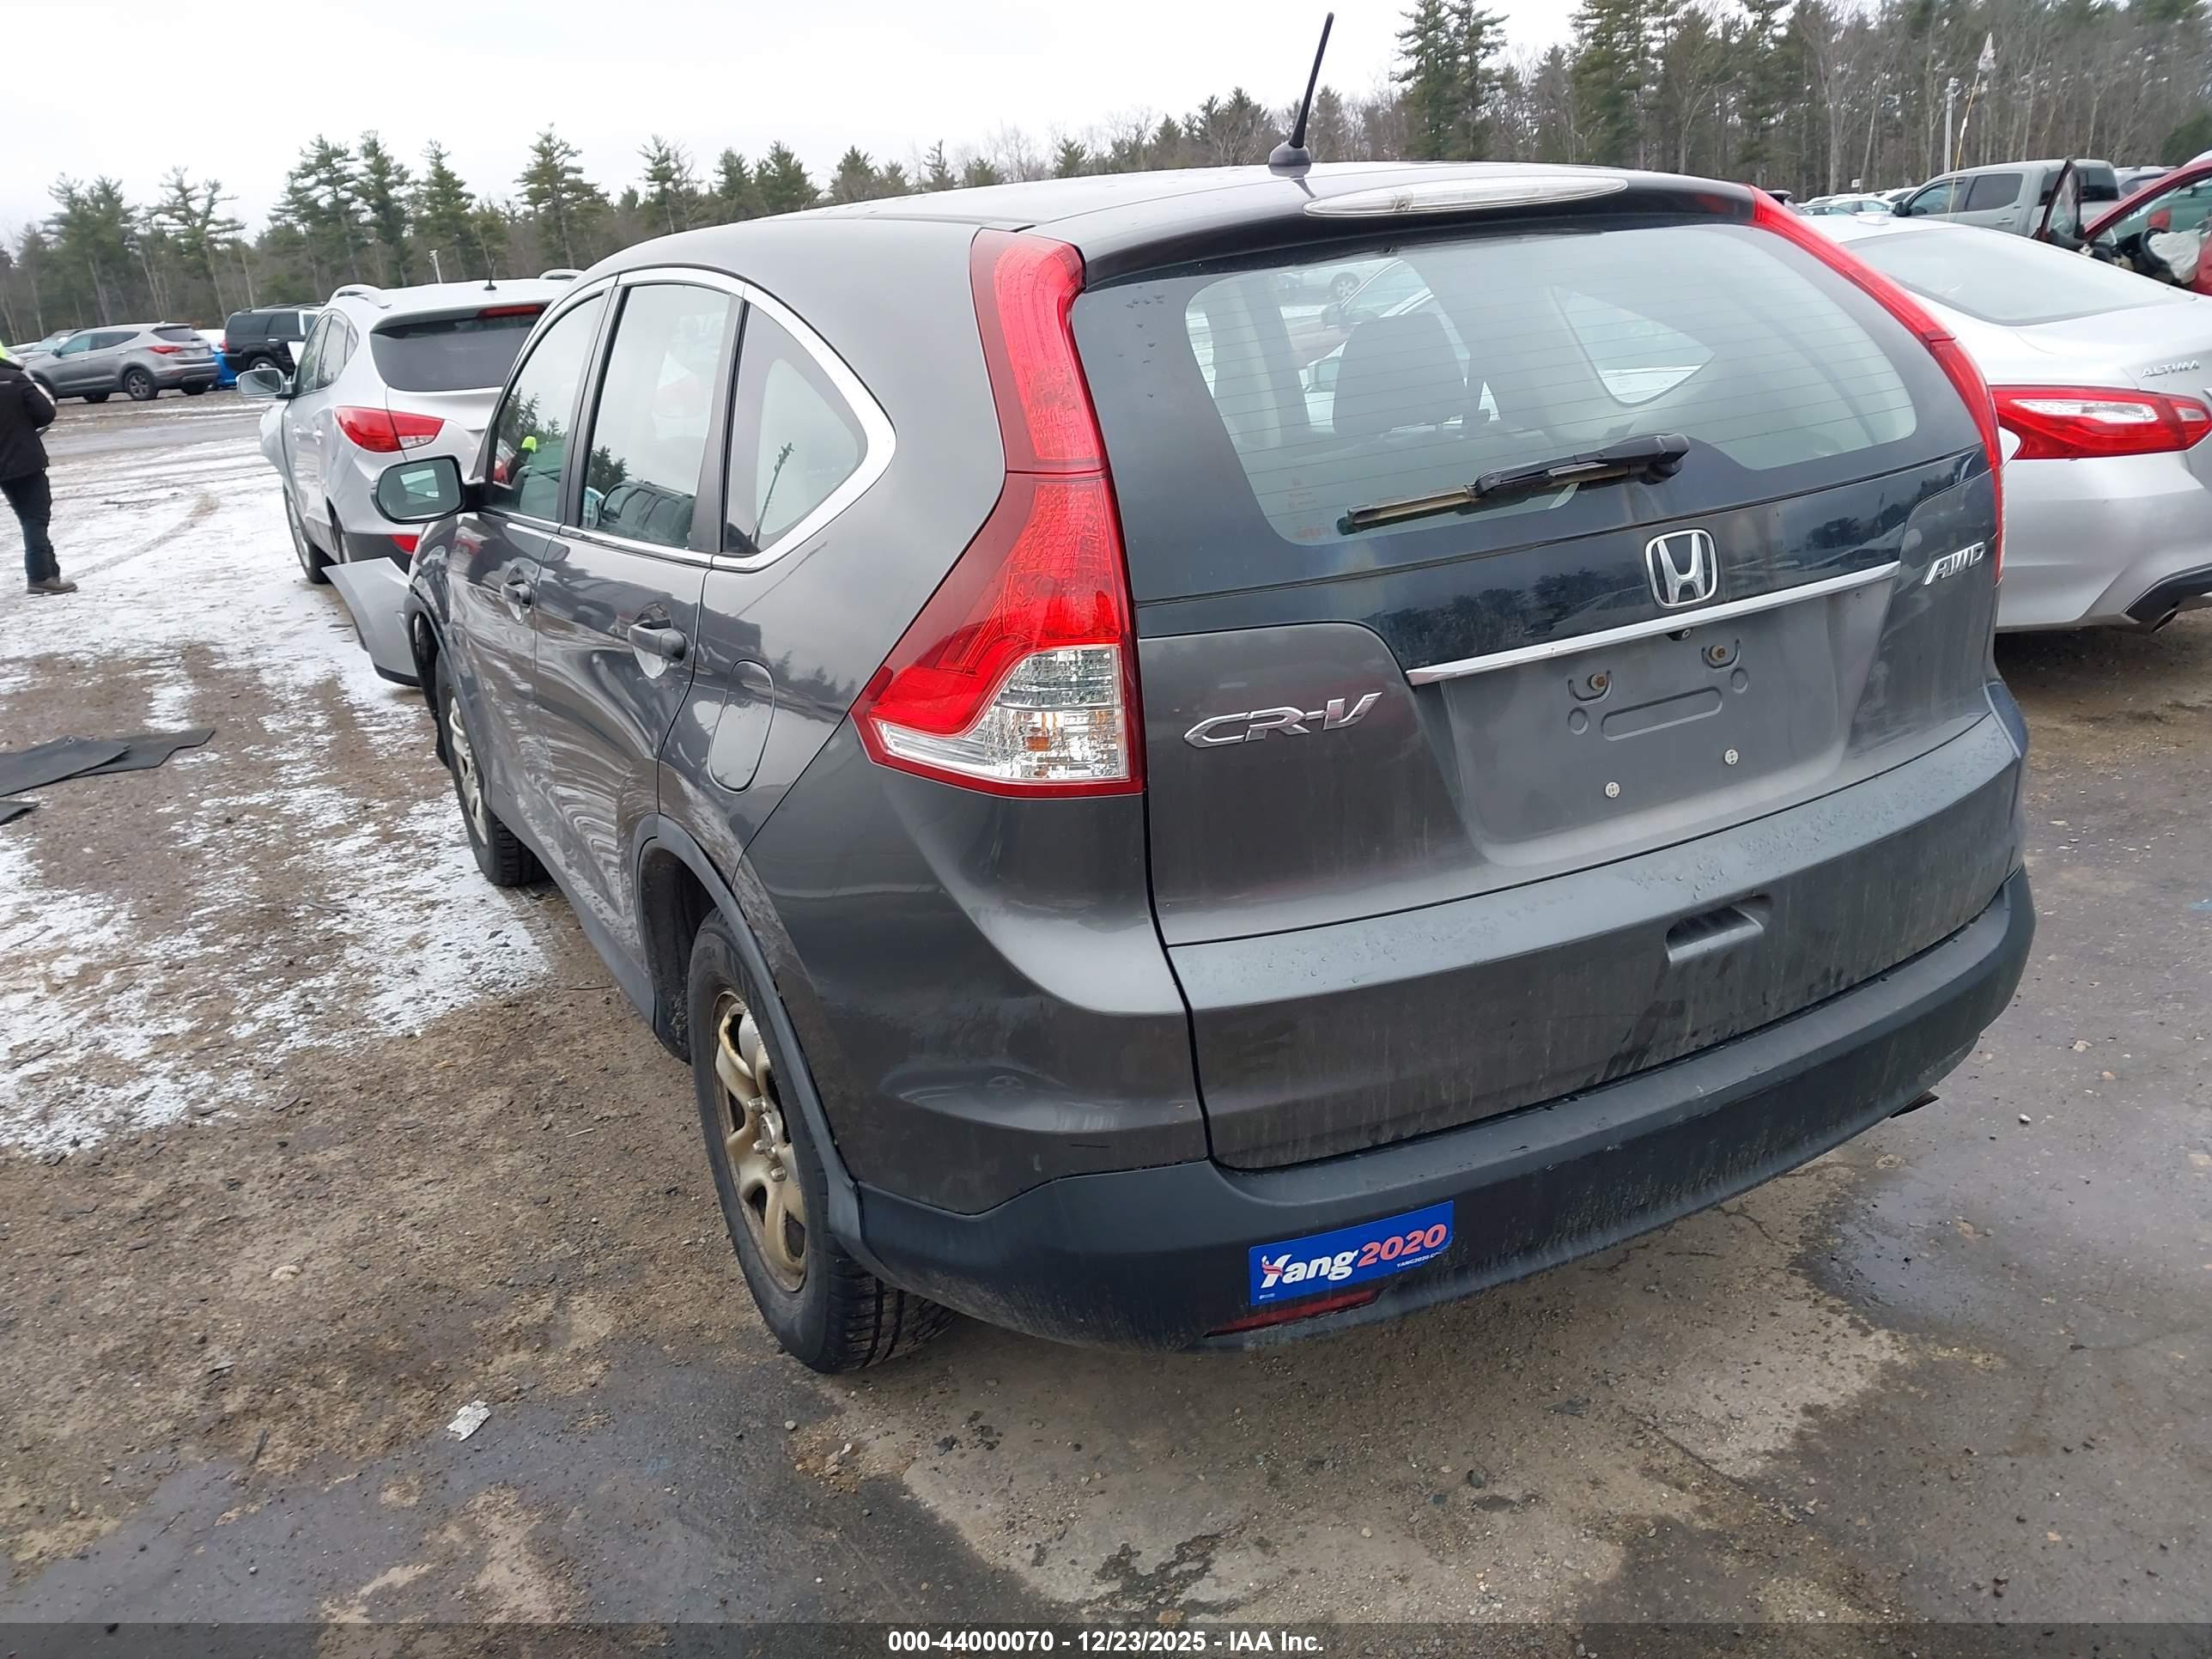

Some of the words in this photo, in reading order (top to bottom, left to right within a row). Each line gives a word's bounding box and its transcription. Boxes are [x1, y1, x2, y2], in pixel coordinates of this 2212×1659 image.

[2141, 360, 2200, 378] ALTIMA
[1923, 541, 1985, 586] AWD
[1184, 691, 1382, 748] CR-V
[1261, 1249, 1359, 1289] Yang
[1357, 1224, 1447, 1267] 2020
